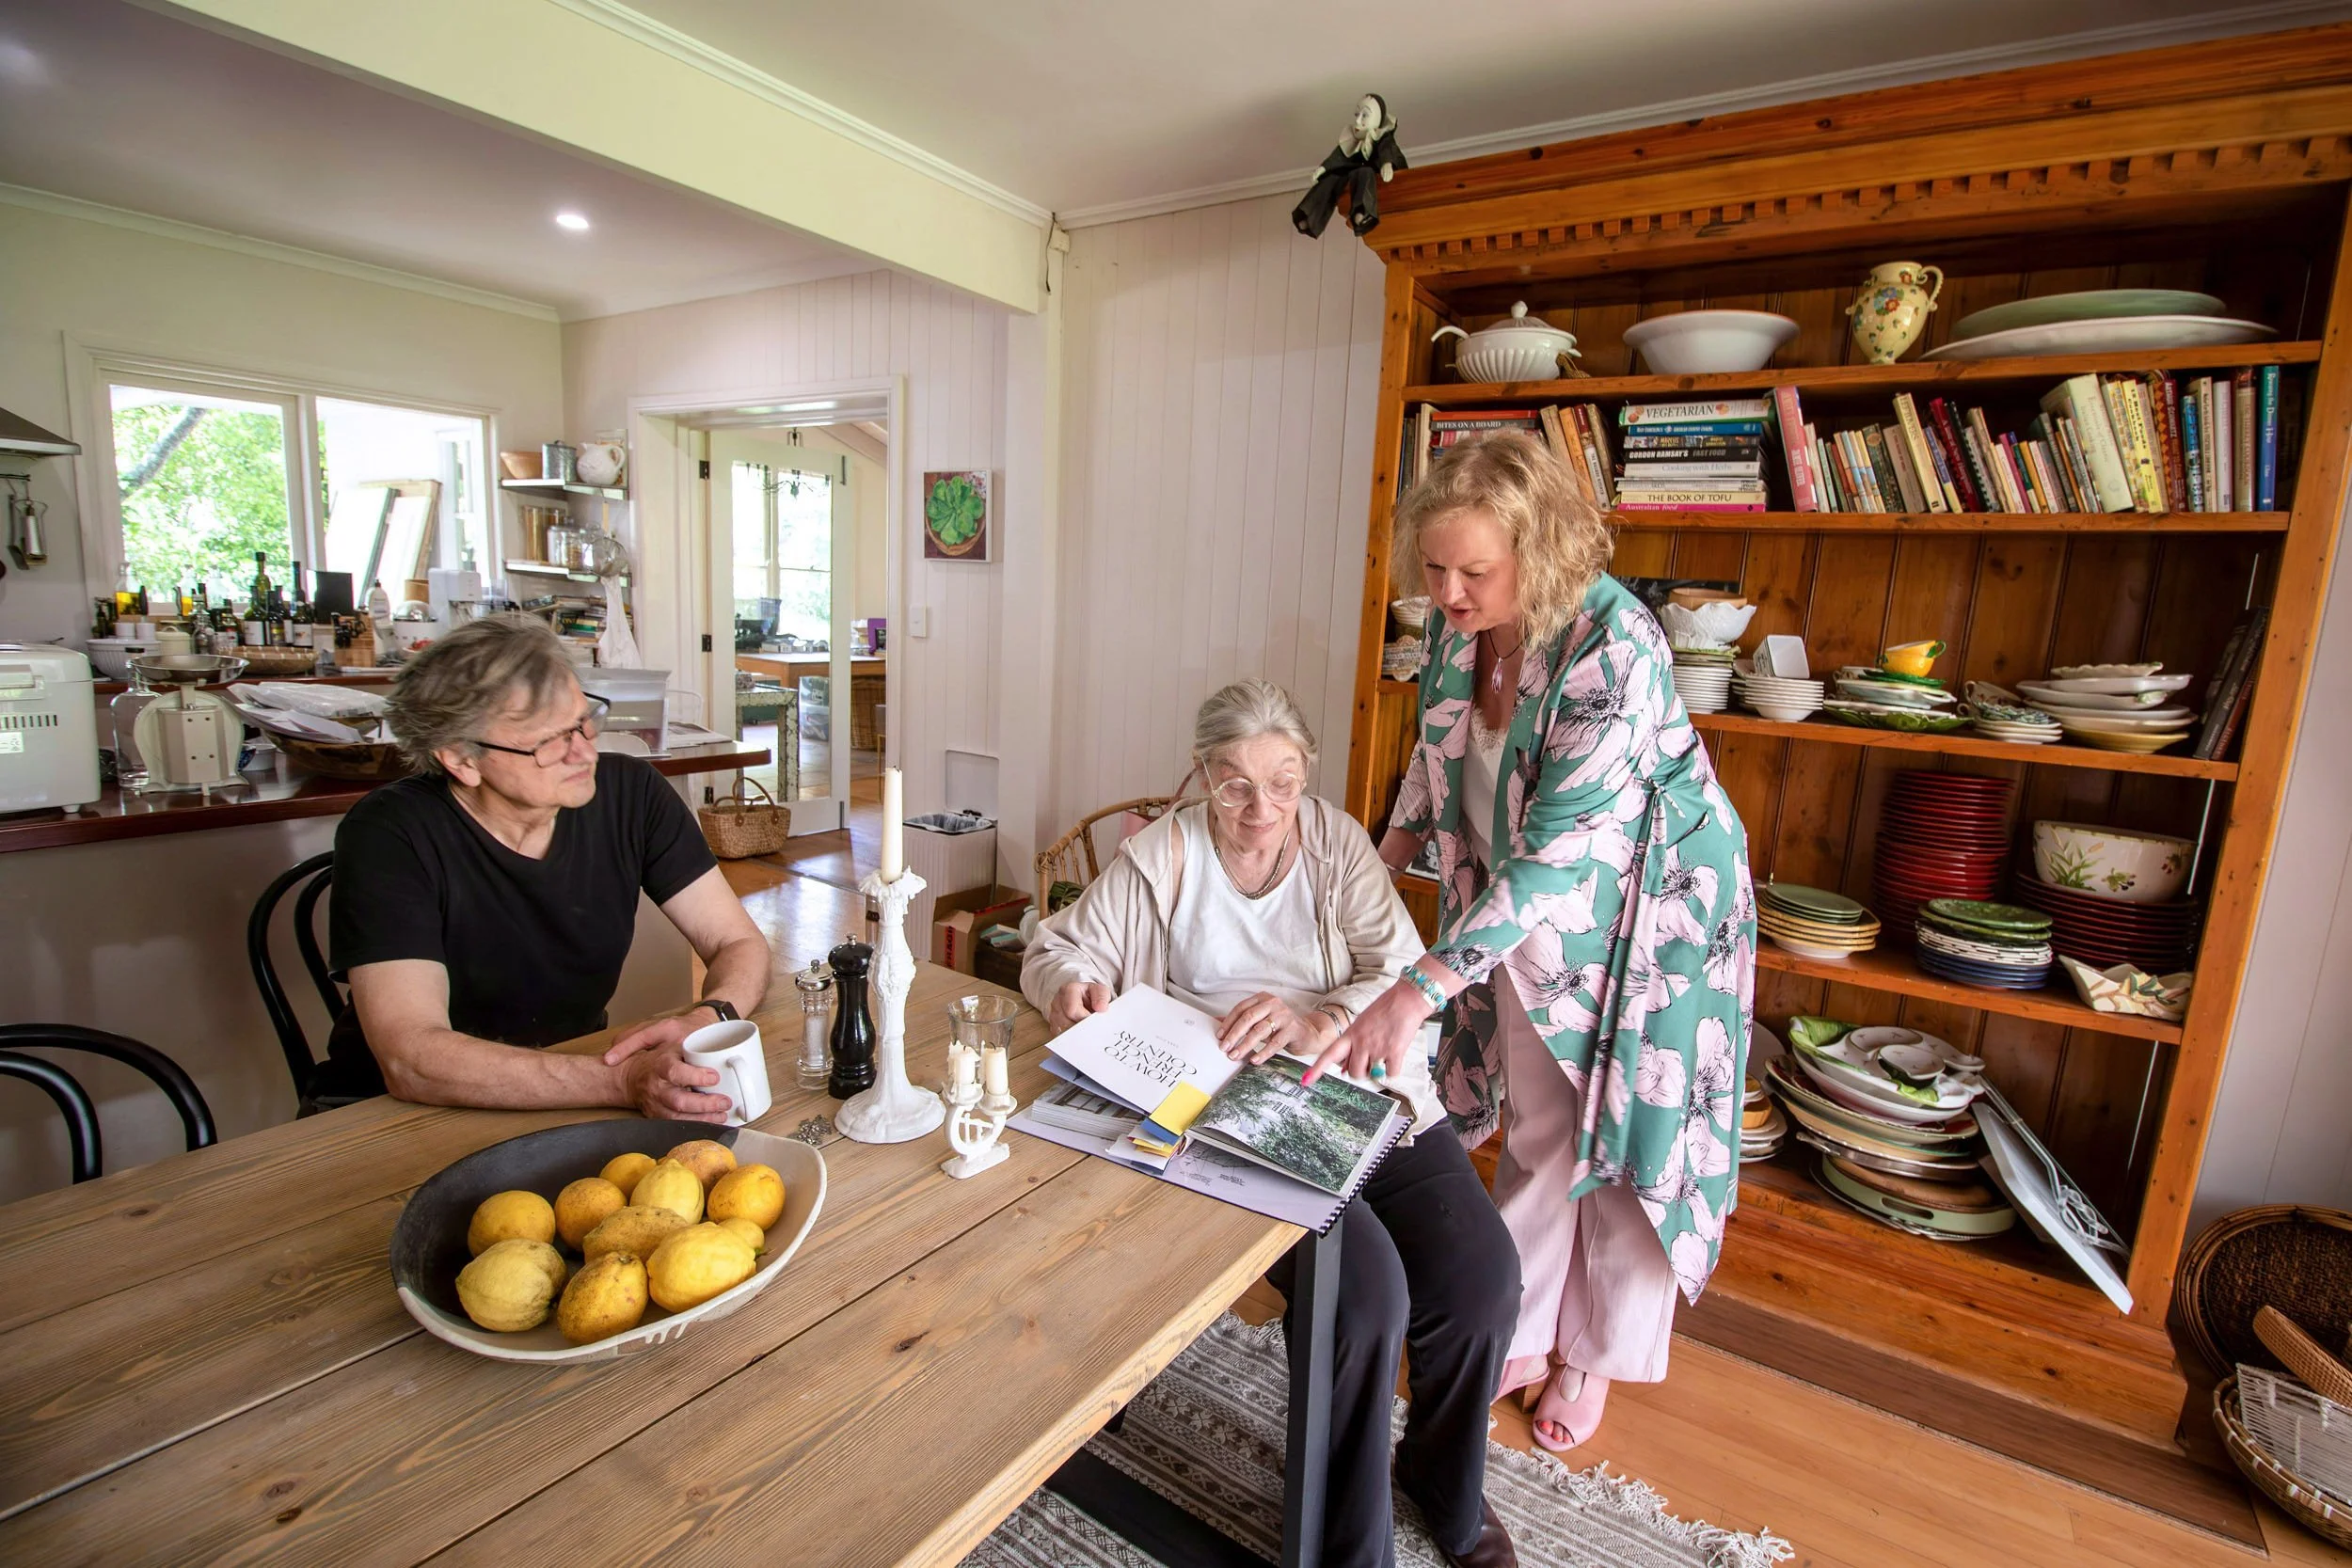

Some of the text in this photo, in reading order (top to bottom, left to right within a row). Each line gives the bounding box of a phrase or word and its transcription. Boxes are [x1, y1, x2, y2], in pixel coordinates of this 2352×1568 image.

[2164, 381, 2176, 405] ARTHUR
[1646, 404, 1714, 419] VEGETARIAN
[2166, 405, 2180, 437] SCHWARTZ
[1629, 451, 1656, 459] GORDON
[1656, 450, 1689, 458] RAMSAY'S
[1104, 1046, 1176, 1087] HOW TO
[1114, 1039, 1182, 1079] FRENCH
[1116, 1030, 1198, 1075] COUNTRY
